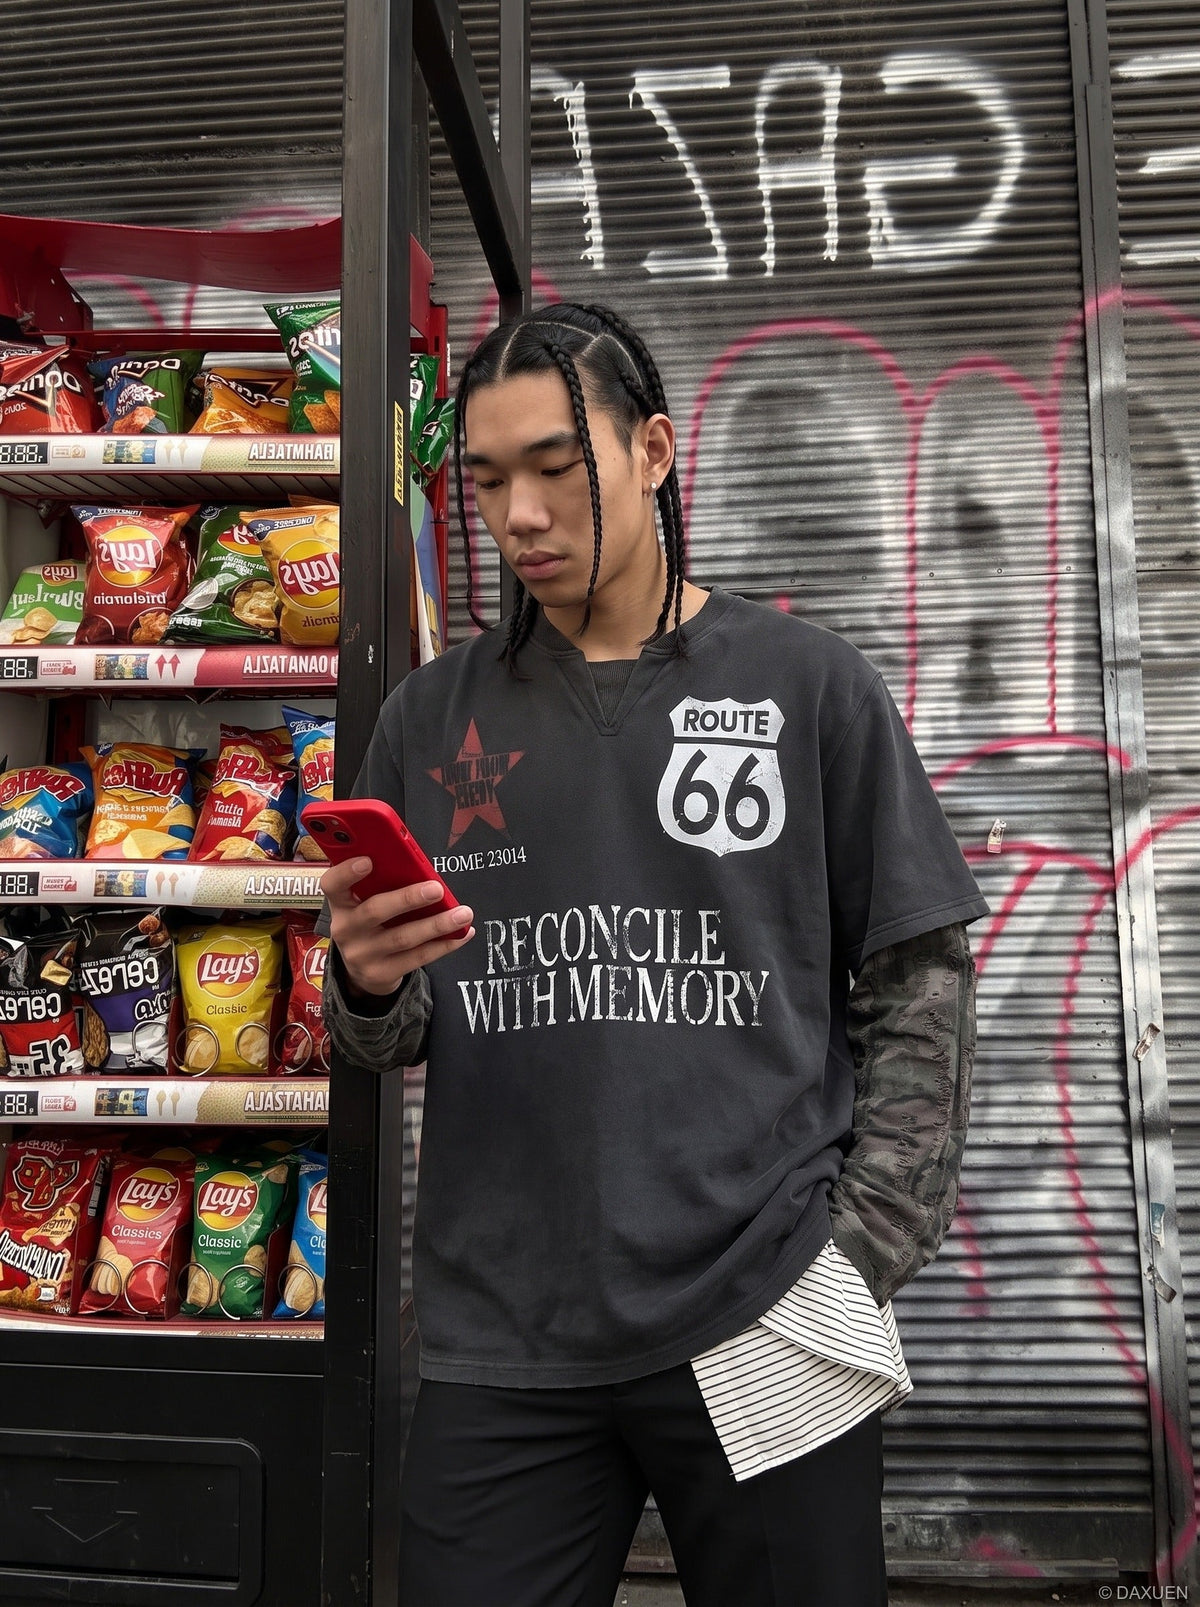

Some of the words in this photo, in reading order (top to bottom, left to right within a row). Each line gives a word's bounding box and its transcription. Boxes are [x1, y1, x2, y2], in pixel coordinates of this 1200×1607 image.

[683, 709, 770, 736] ROUTE
[672, 749, 771, 841] 66
[433, 853, 485, 874] HOME
[487, 846, 528, 869] 23014
[484, 905, 727, 974] RECONCILE
[201, 951, 257, 984] Lay's
[206, 1003, 247, 1015] Classic
[457, 971, 557, 1034] WITH
[568, 965, 770, 1027] MEMORY
[120, 1179, 176, 1209] Lay's
[200, 1182, 256, 1216] Lay's
[112, 1224, 163, 1240] Classics
[198, 1234, 242, 1249] Classic
